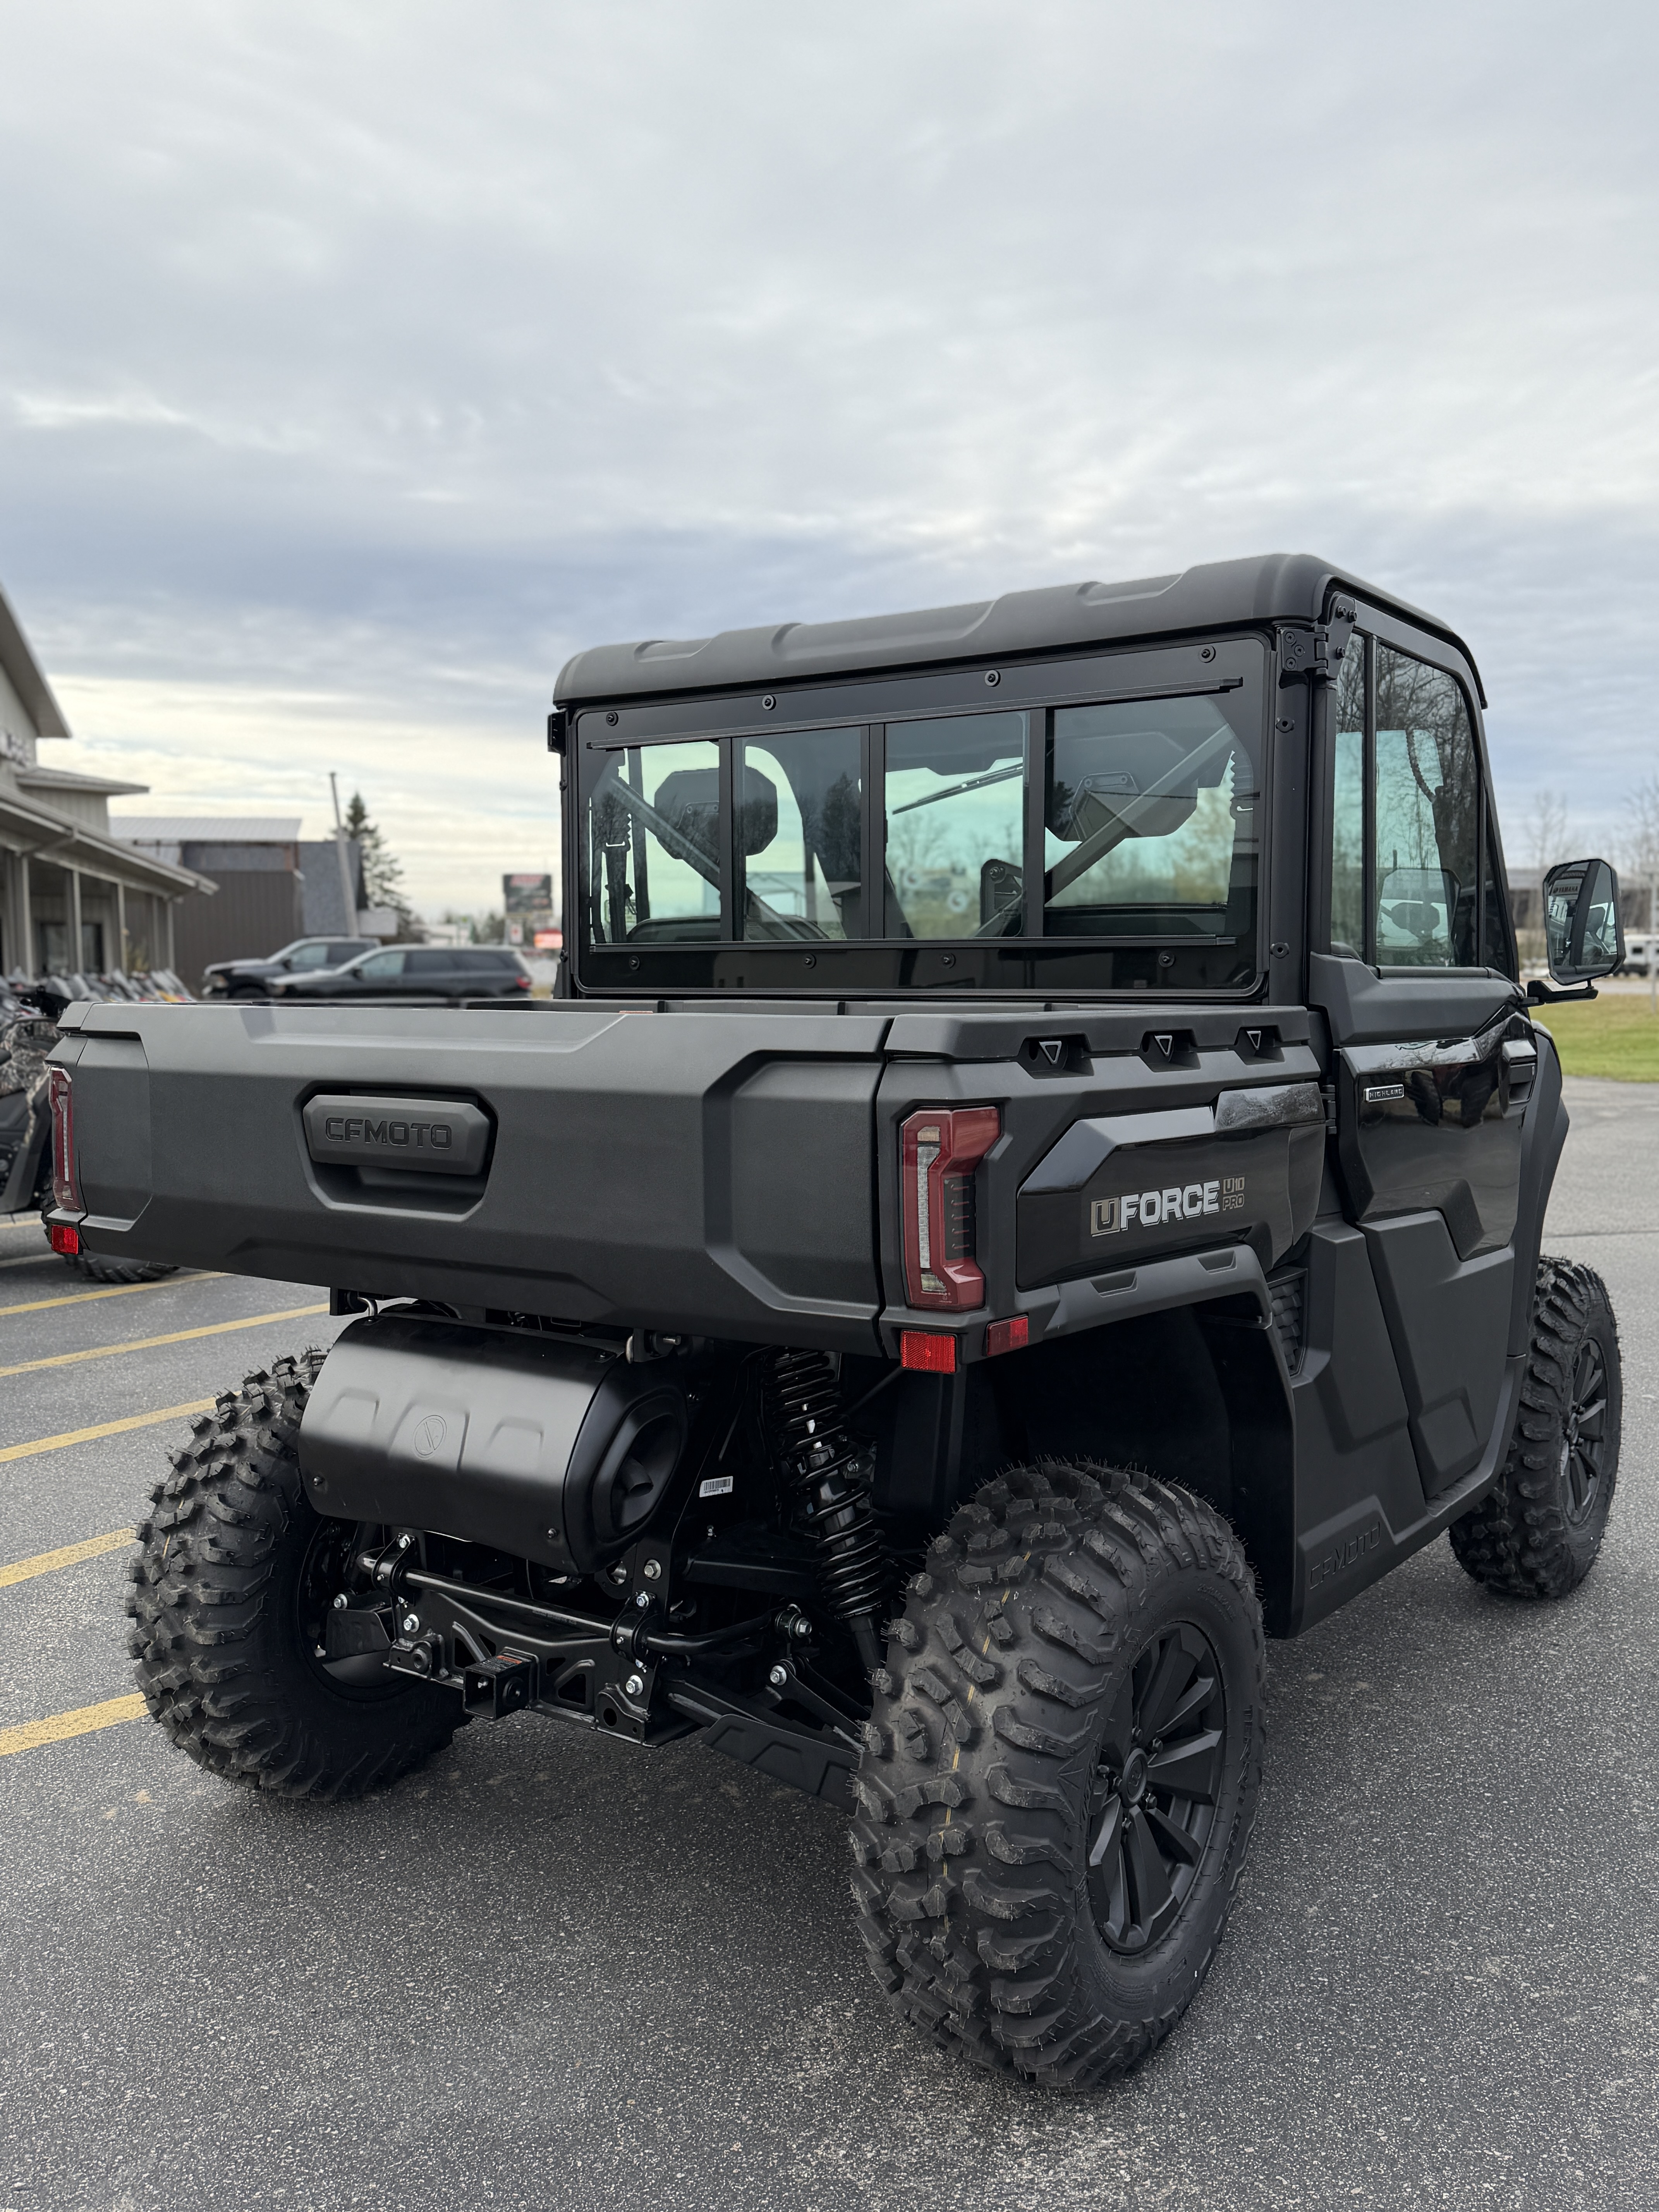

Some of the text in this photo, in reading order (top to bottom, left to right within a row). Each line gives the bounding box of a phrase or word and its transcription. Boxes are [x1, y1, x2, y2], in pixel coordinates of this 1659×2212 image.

[326, 1117, 452, 1150] CFMOTO
[1091, 1180, 1220, 1237] UFORCE
[1222, 1193, 1245, 1211] PRO
